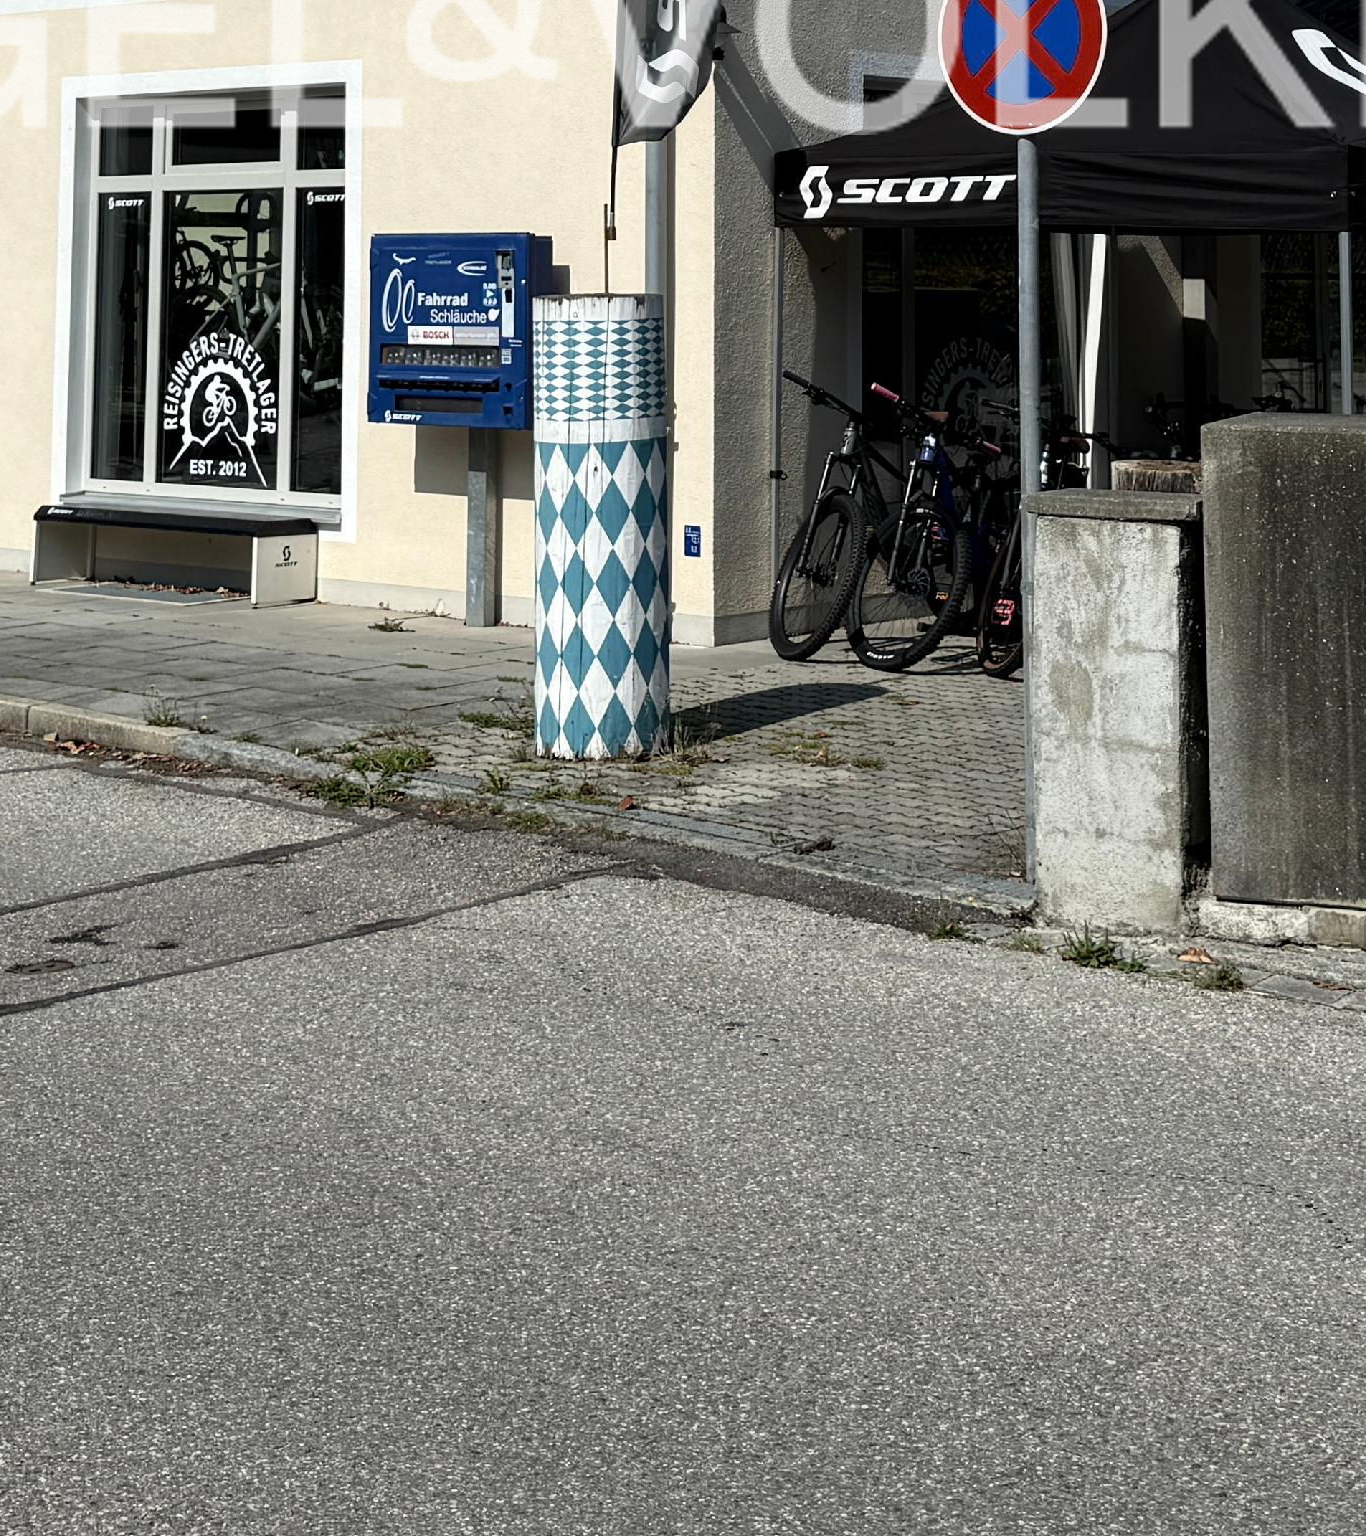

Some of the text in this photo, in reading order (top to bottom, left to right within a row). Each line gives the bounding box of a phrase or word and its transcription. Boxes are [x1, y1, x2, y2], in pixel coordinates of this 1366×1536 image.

[837, 173, 1018, 205] SCOTT
[114, 198, 145, 208] SCOTT
[417, 292, 469, 306] Fahrrad
[430, 309, 488, 324] Schläuche
[422, 330, 450, 340] BOSCH
[163, 332, 278, 435] REISINGERS-TRETLAGER
[189, 459, 247, 478] EST. 2012
